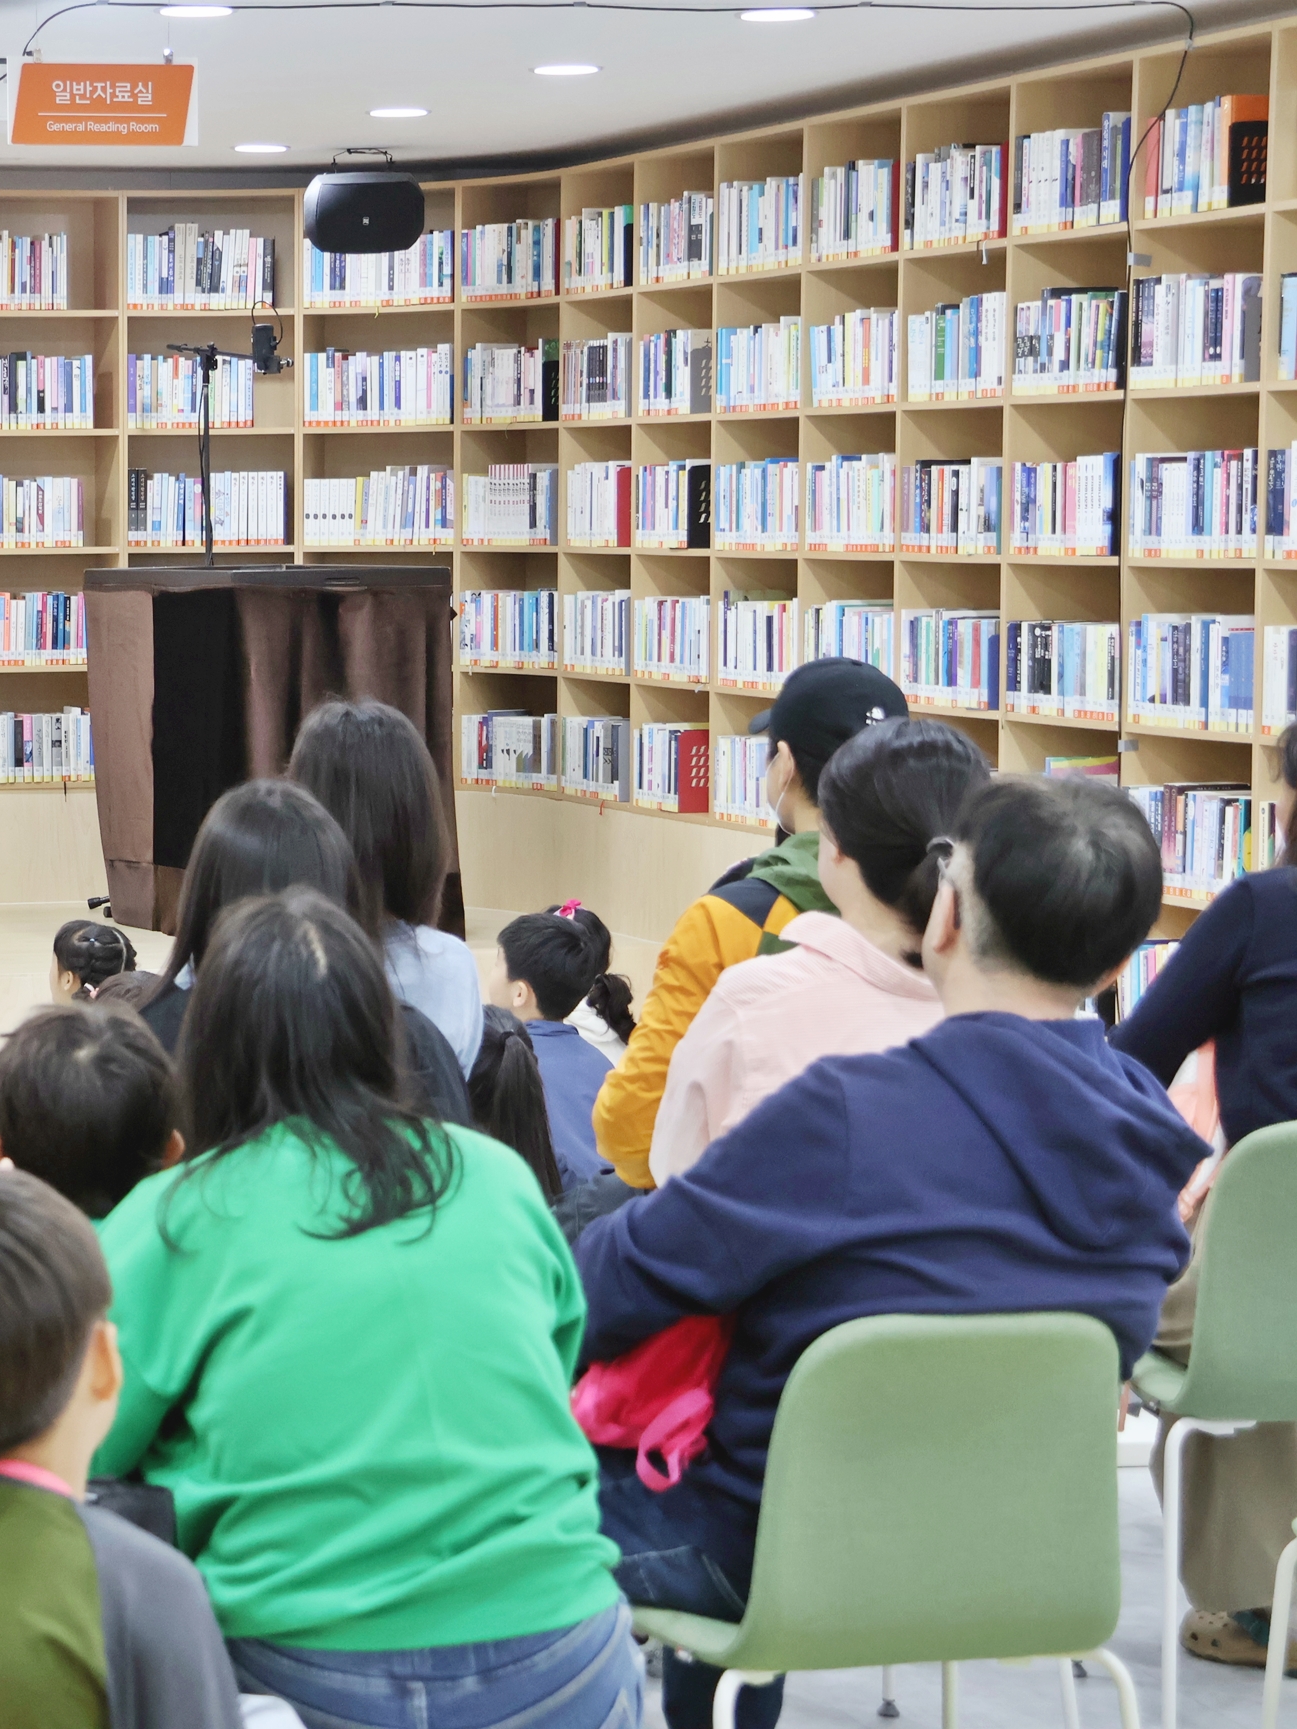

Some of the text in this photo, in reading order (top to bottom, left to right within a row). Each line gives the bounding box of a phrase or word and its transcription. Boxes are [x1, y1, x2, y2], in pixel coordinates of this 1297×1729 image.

[51, 80, 153, 105] 일반자료실
[46, 120, 159, 134] General Reading Room
